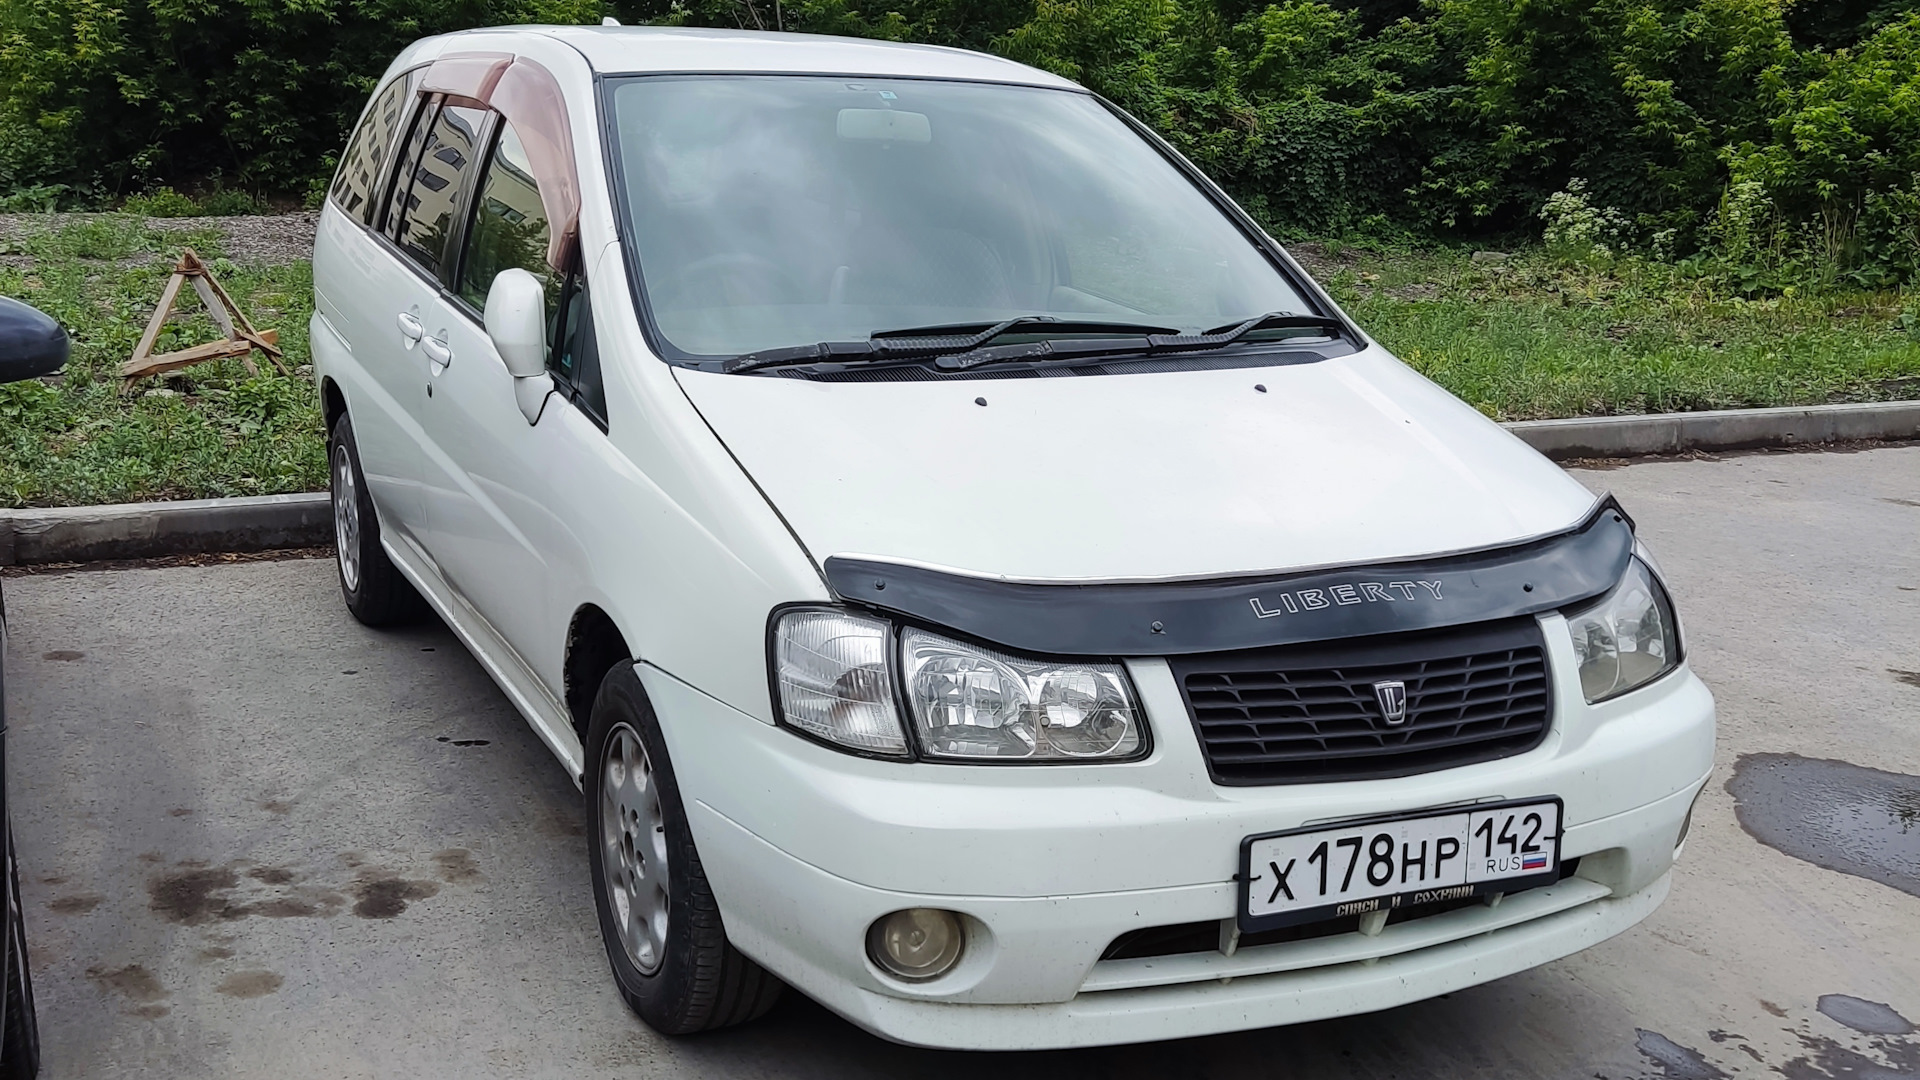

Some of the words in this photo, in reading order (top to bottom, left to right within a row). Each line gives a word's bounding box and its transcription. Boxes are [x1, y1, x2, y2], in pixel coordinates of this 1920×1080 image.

[1249, 580, 1444, 619] LIBERTY
[1474, 812, 1543, 858] 142
[1486, 856, 1521, 874] RUS
